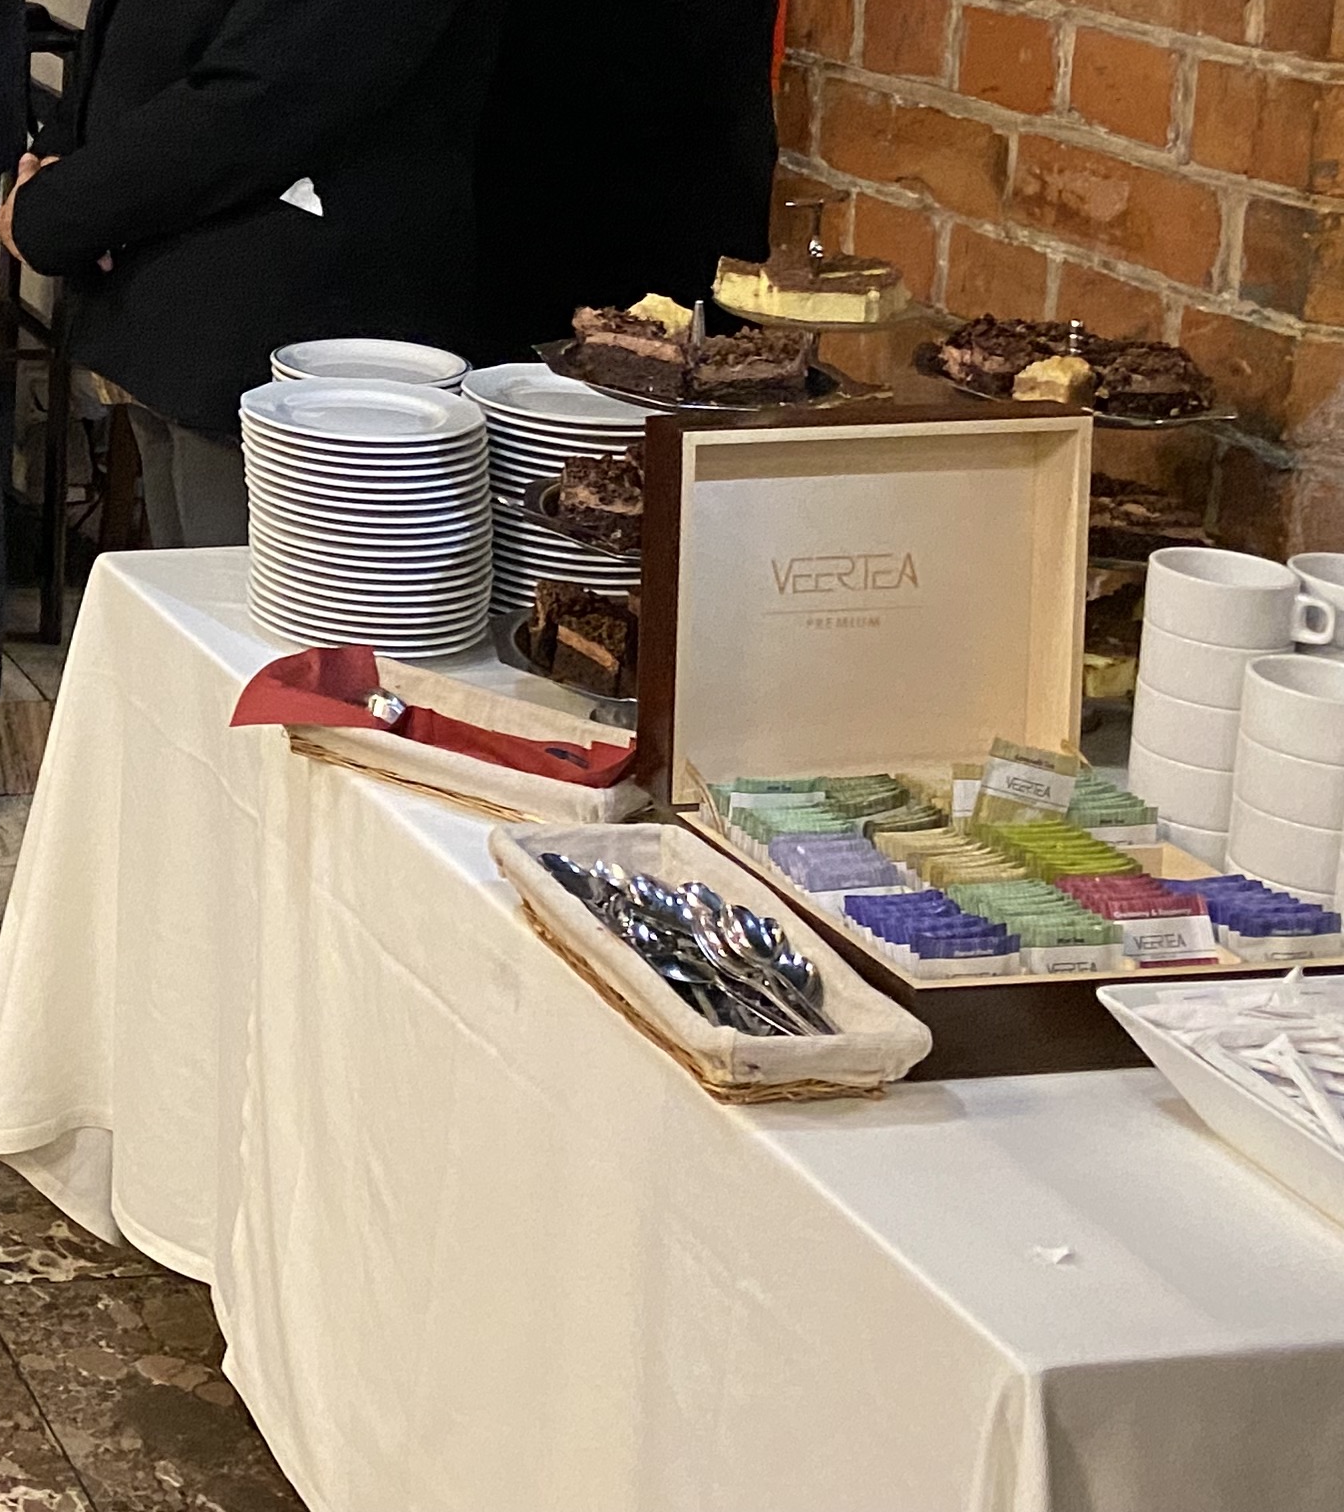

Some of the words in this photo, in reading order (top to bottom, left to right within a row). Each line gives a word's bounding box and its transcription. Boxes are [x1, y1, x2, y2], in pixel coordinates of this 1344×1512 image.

[771, 552, 918, 595] VEERTEA
[806, 616, 880, 629] PREMIUM
[1006, 775, 1050, 798] VEERTEA
[1133, 933, 1187, 950] VEERTEA
